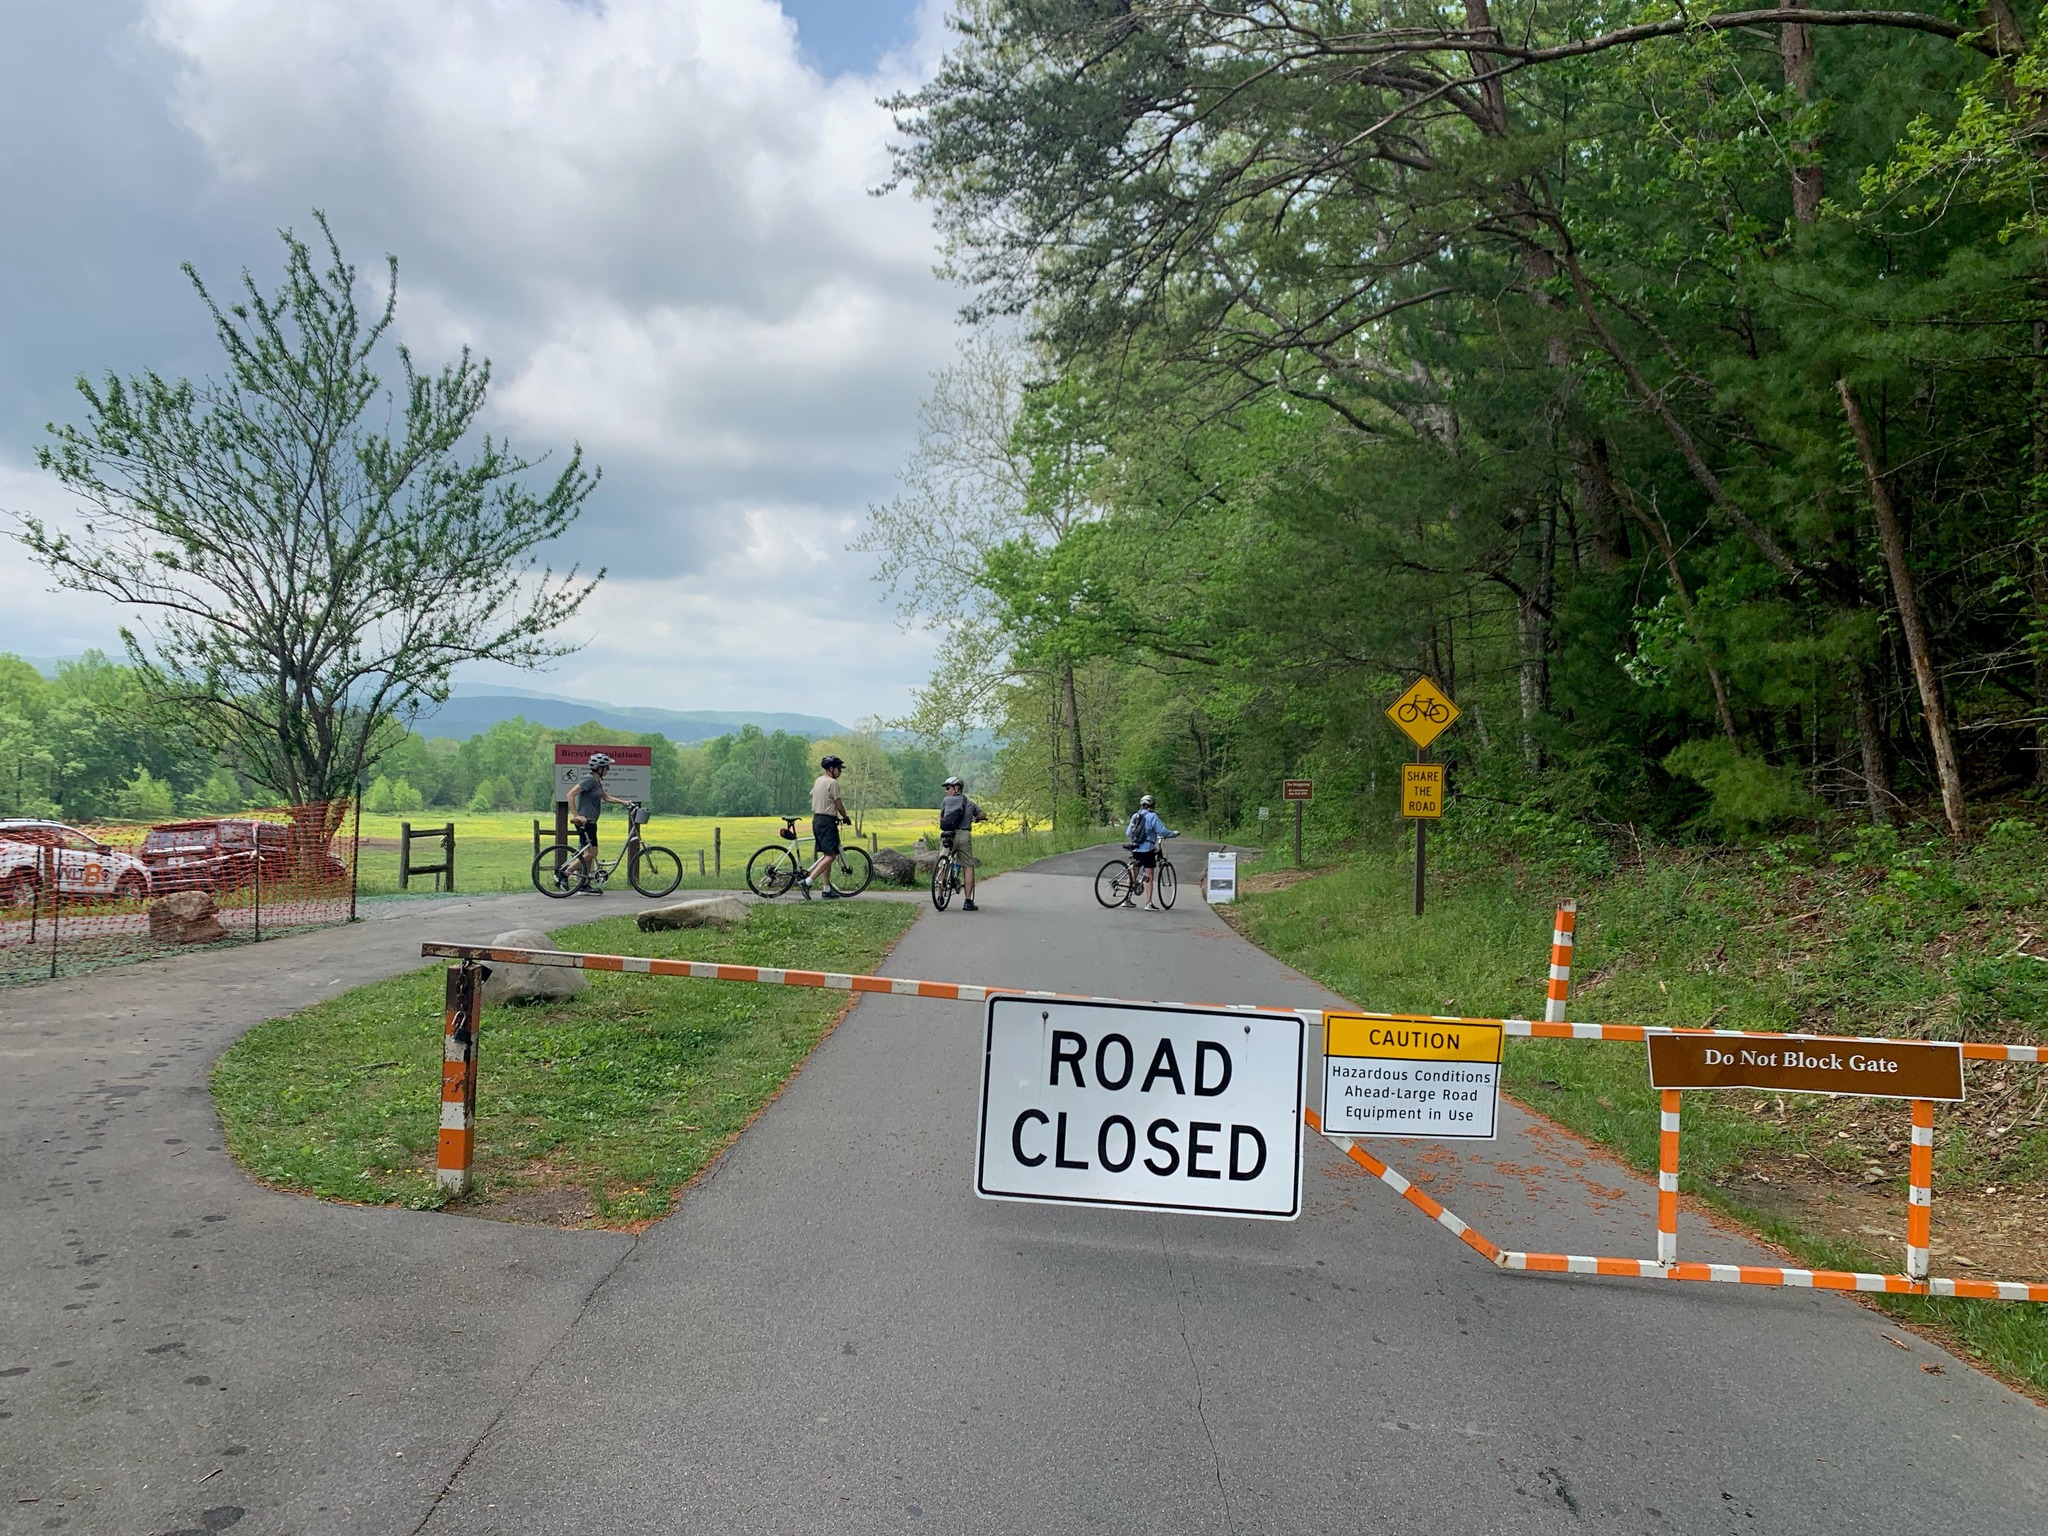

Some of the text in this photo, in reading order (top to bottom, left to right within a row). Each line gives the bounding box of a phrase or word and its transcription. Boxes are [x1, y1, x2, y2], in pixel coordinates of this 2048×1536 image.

[561, 750, 642, 759] Bicycle ulations
[1407, 771, 1439, 782] SHARE
[1414, 786, 1432, 796] THE
[1409, 801, 1436, 812] ROAD
[1369, 1029, 1460, 1050] CAUTION
[1049, 1030, 1233, 1097] ROAD
[1704, 1049, 1899, 1074] Do Not Block Gate
[1332, 1065, 1491, 1084] Hazardous Conditions
[1345, 1085, 1478, 1103] Ahead-Large Road
[1346, 1105, 1474, 1121] Equipment in Use
[1011, 1108, 1267, 1181] CLOSED
